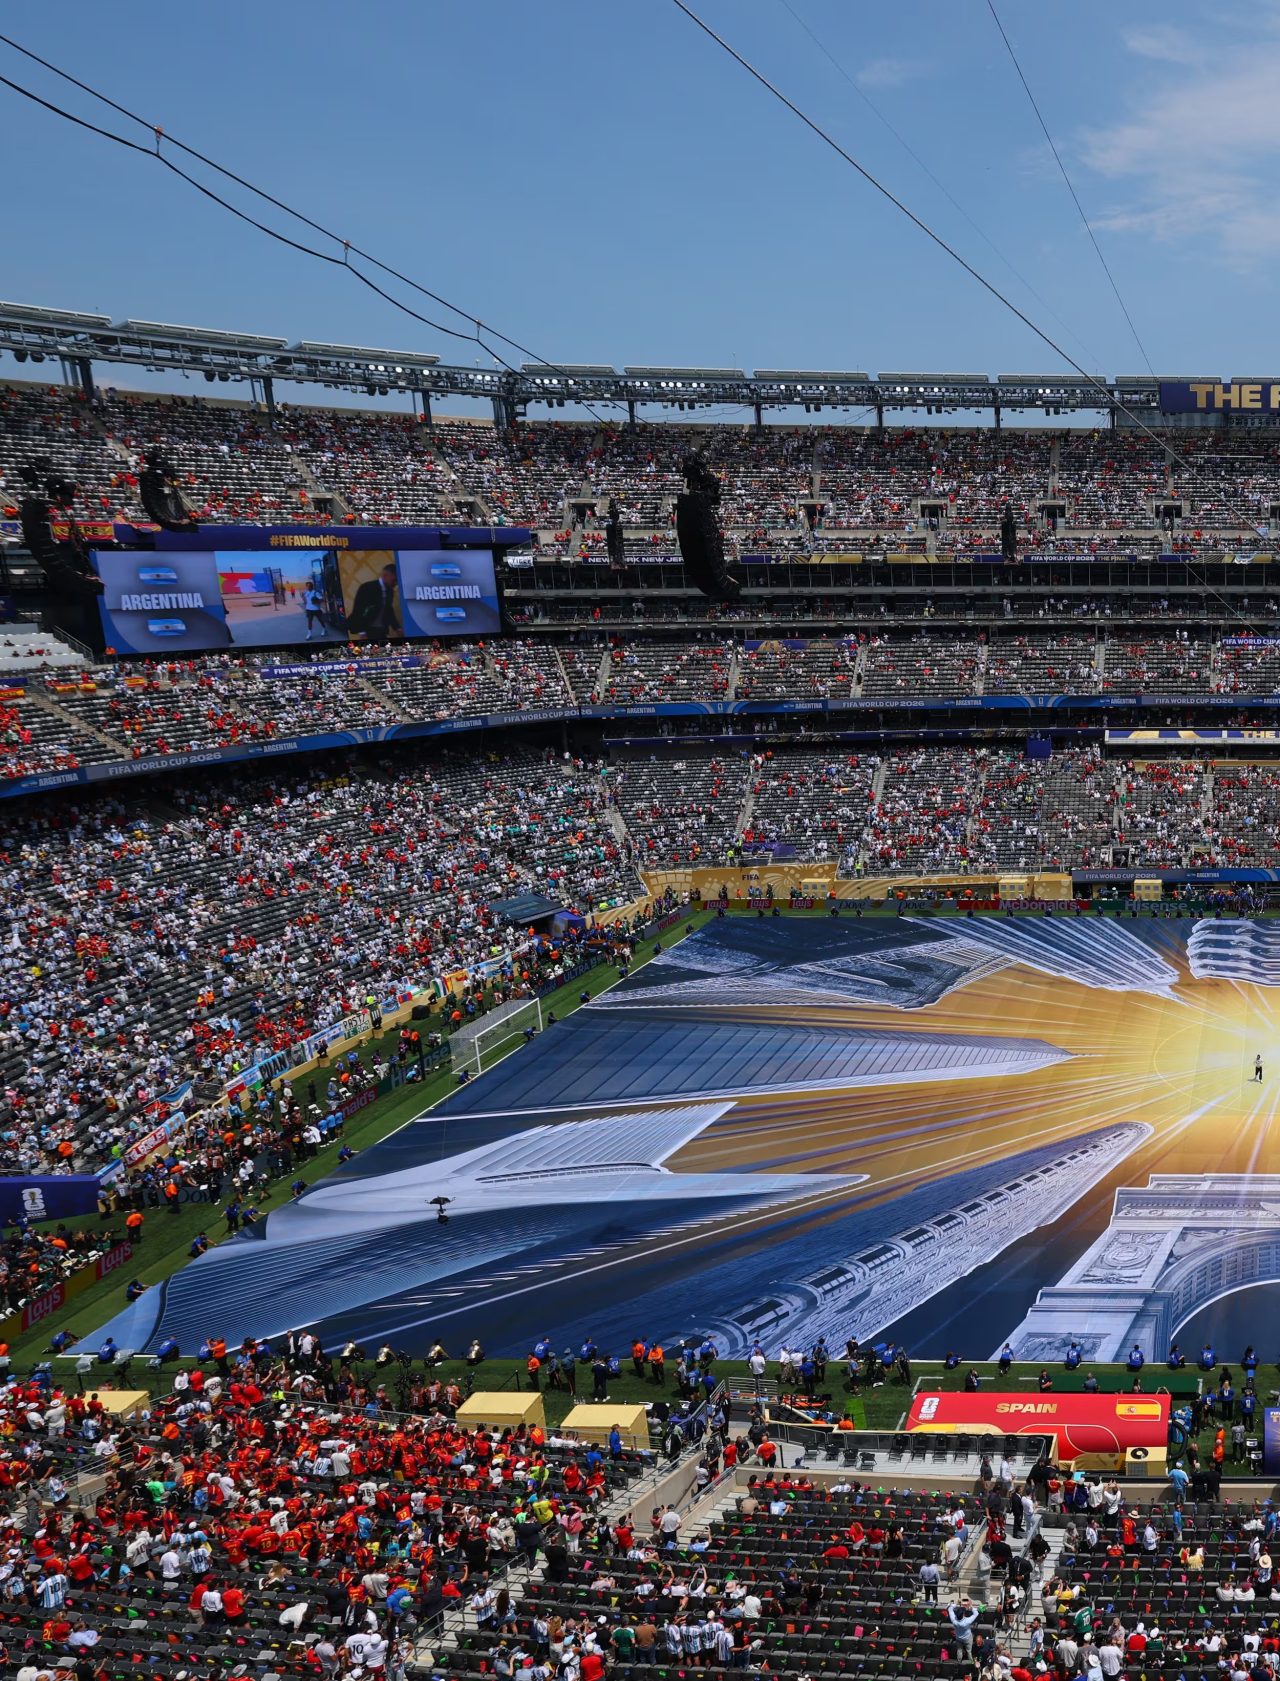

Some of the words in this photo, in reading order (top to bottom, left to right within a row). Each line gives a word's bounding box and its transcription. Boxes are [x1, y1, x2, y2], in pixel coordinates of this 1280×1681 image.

[1189, 384, 1263, 408] THE
[270, 535, 350, 549] #FIFAWorldCup
[416, 584, 481, 601] ARGENTINA
[121, 592, 205, 611] ARGENTINA
[453, 719, 483, 728] ARGENTINA
[504, 715, 520, 723] FIFA
[521, 713, 549, 722] WORLD
[1240, 731, 1276, 739] THE
[263, 742, 298, 753] ARGENTINA
[109, 766, 131, 776] FIFA
[132, 761, 169, 773] WORLD
[169, 757, 189, 768] CUP
[189, 752, 222, 765] 2026
[38, 773, 79, 787] ARGENTINA
[839, 900, 866, 910] Dove
[898, 900, 926, 910] Dove
[998, 900, 1079, 910] McDonald's
[1124, 900, 1189, 910] Hisense
[391, 1046, 449, 1088] Hinse
[178, 1187, 213, 1203] Dov
[996, 1403, 1057, 1413] SPAIN
[49, 1582, 61, 1595] 10
[352, 1644, 364, 1654] 10
